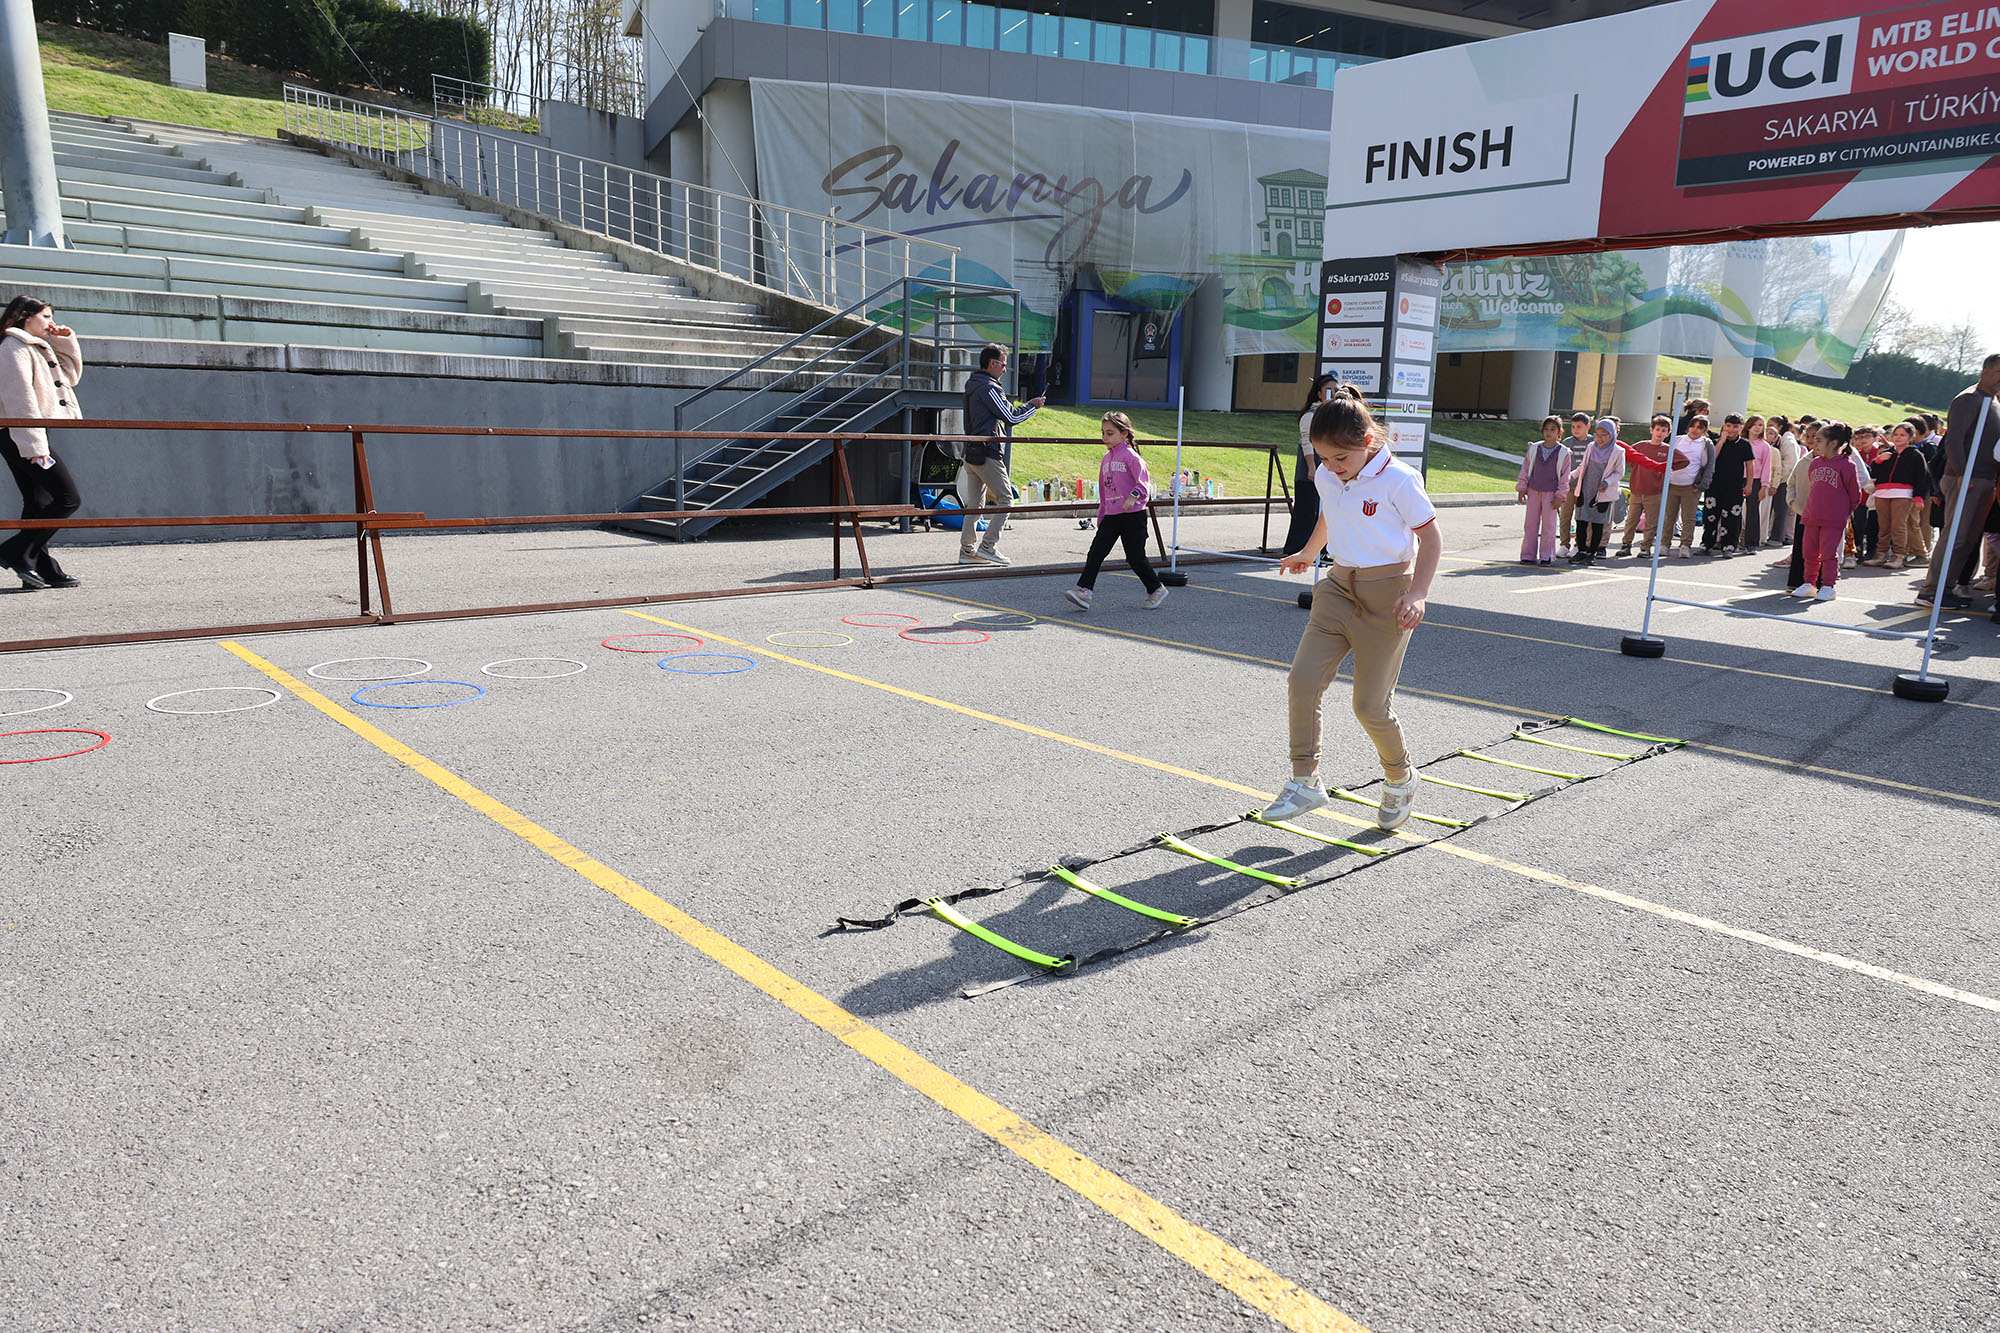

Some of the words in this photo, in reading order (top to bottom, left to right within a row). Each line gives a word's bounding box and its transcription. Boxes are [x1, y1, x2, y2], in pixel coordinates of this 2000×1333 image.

[1870, 16, 1932, 49] MTB
[1714, 34, 1843, 97] UCI
[1867, 42, 1977, 77] WORLD
[1763, 107, 1879, 141] SAKARYA
[1365, 125, 1513, 184] FINISH
[1748, 154, 1816, 171] POWERED
[1819, 151, 1837, 163] BY
[821, 138, 1192, 272] Sakarya
[1327, 272, 1390, 284] #Sakarya2025
[1400, 272, 1439, 287] #Sakarya2025
[1480, 299, 1566, 315] Welcome
[1402, 403, 1416, 414] UCI
